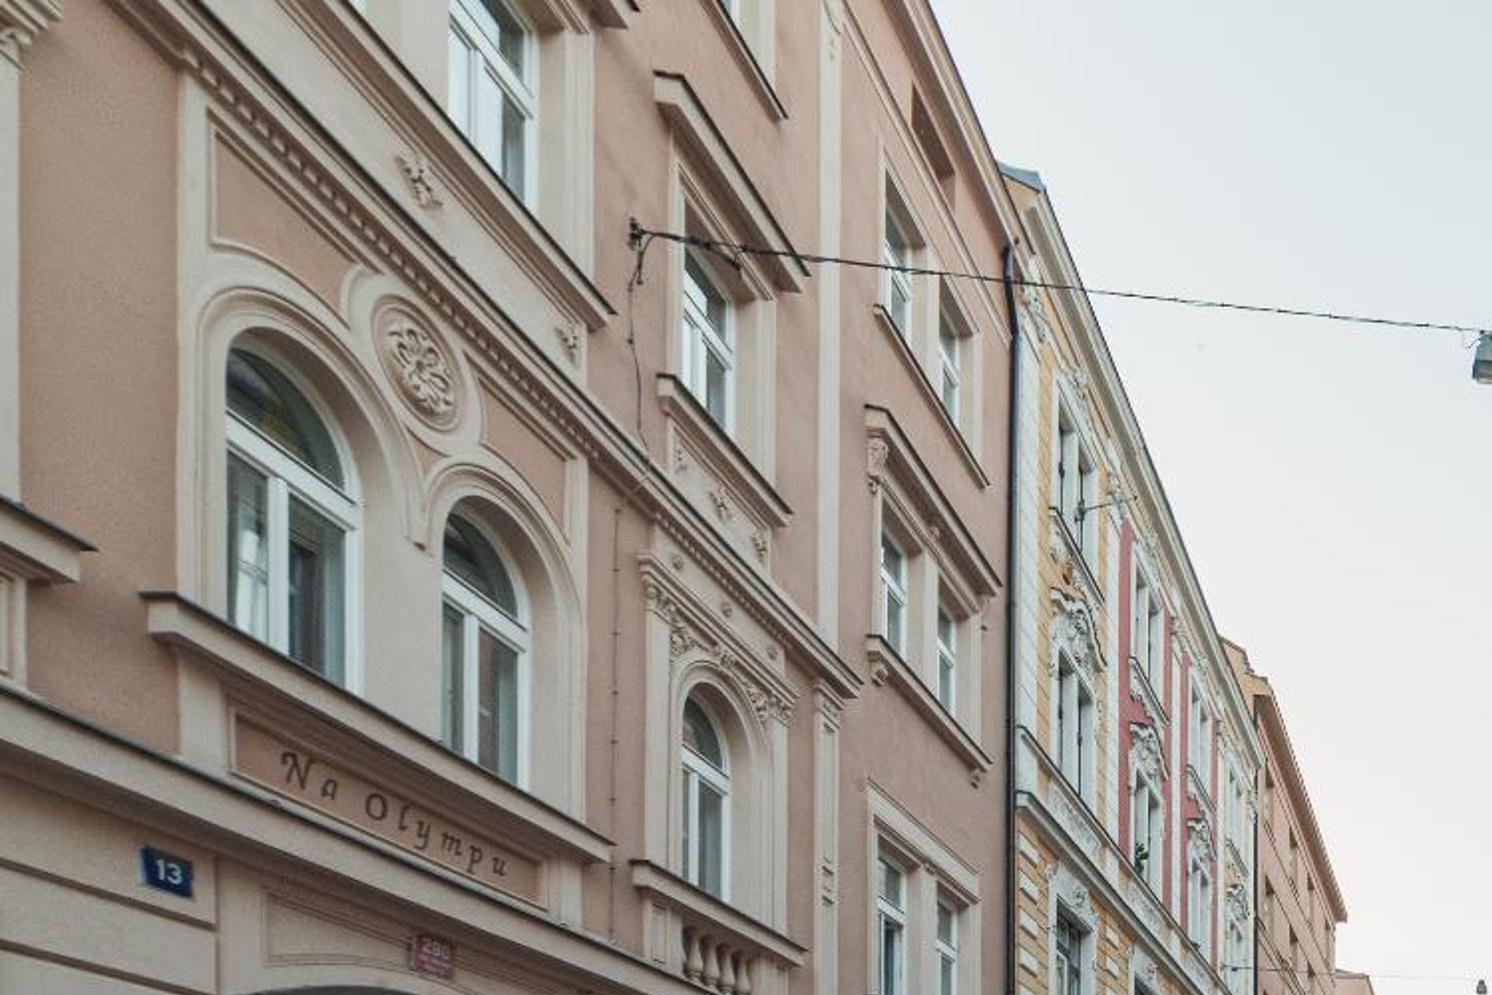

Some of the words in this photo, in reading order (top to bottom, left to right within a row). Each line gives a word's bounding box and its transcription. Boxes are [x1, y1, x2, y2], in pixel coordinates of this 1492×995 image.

[281, 752, 338, 800] Na
[365, 793, 507, 876] Olympu
[156, 859, 182, 885] 13
